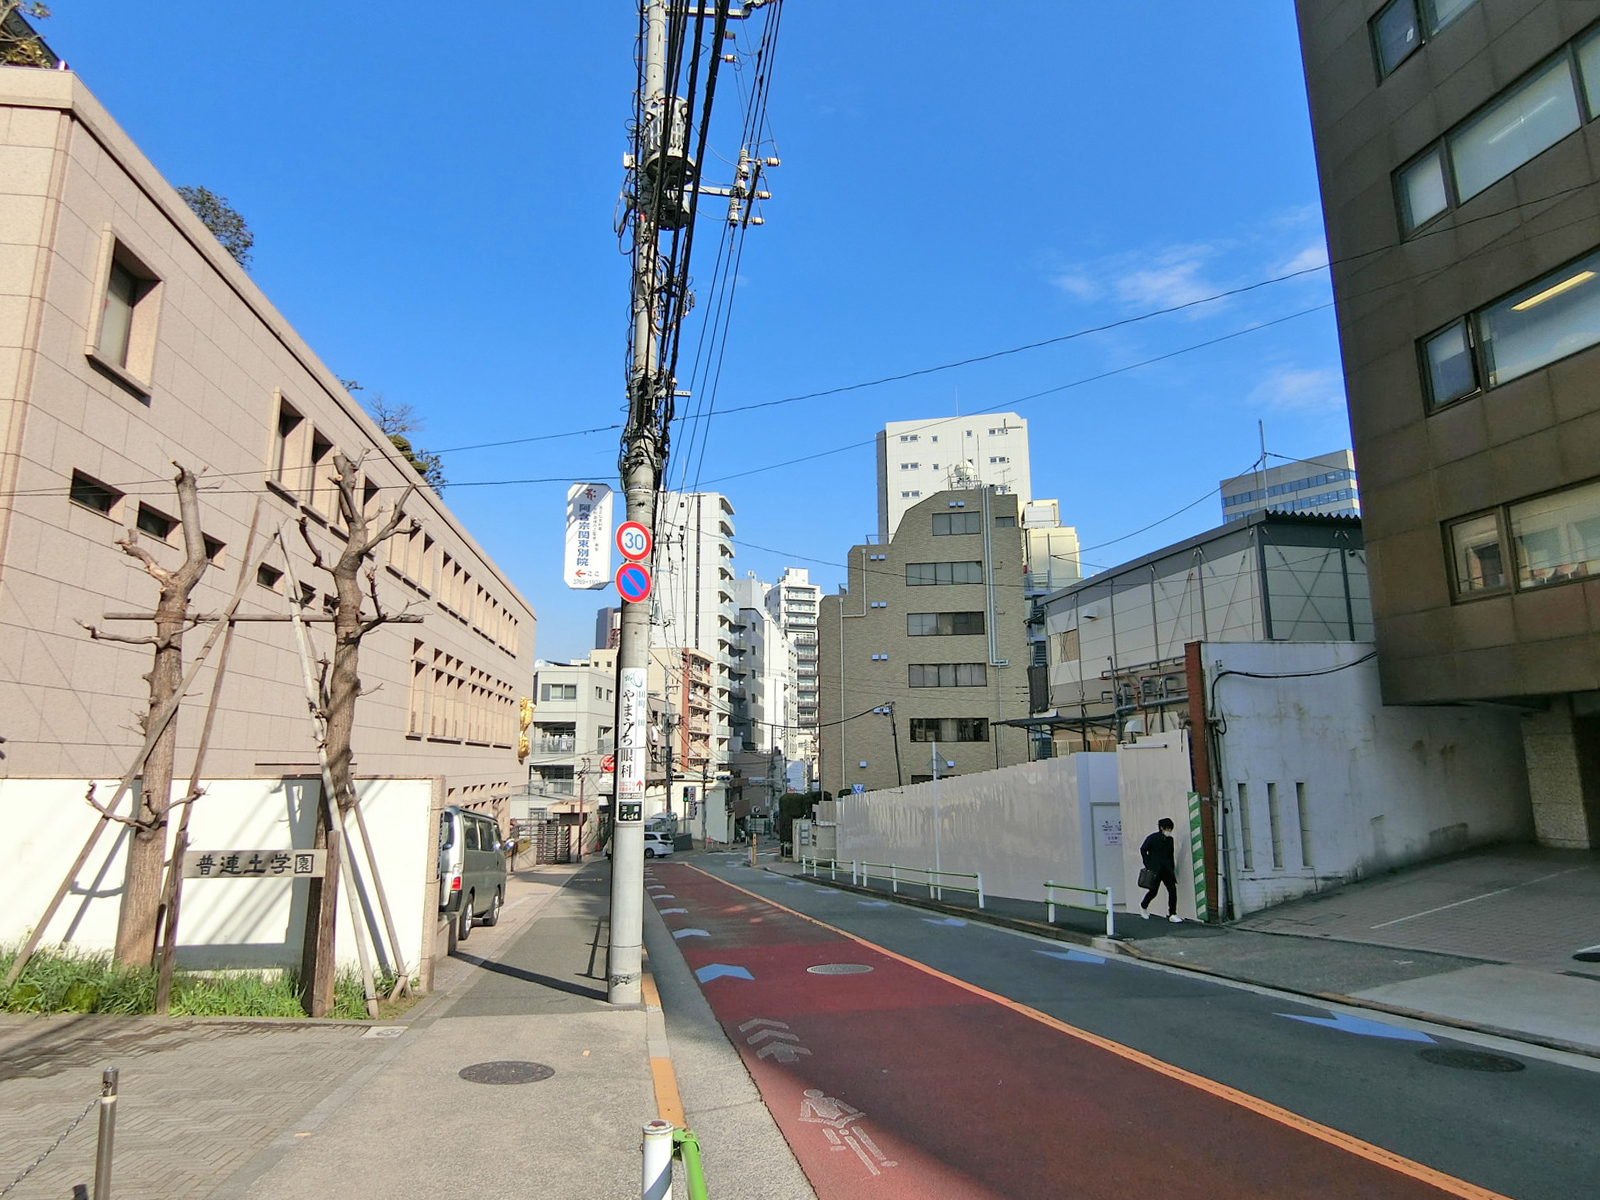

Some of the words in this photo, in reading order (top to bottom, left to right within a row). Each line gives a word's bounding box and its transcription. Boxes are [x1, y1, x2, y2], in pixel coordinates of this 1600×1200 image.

[576, 503, 591, 567] 阿含宗関東別院
[624, 532, 644, 550] 30
[620, 689, 635, 779] やまうち眼科
[195, 853, 315, 876] 普連土学園
